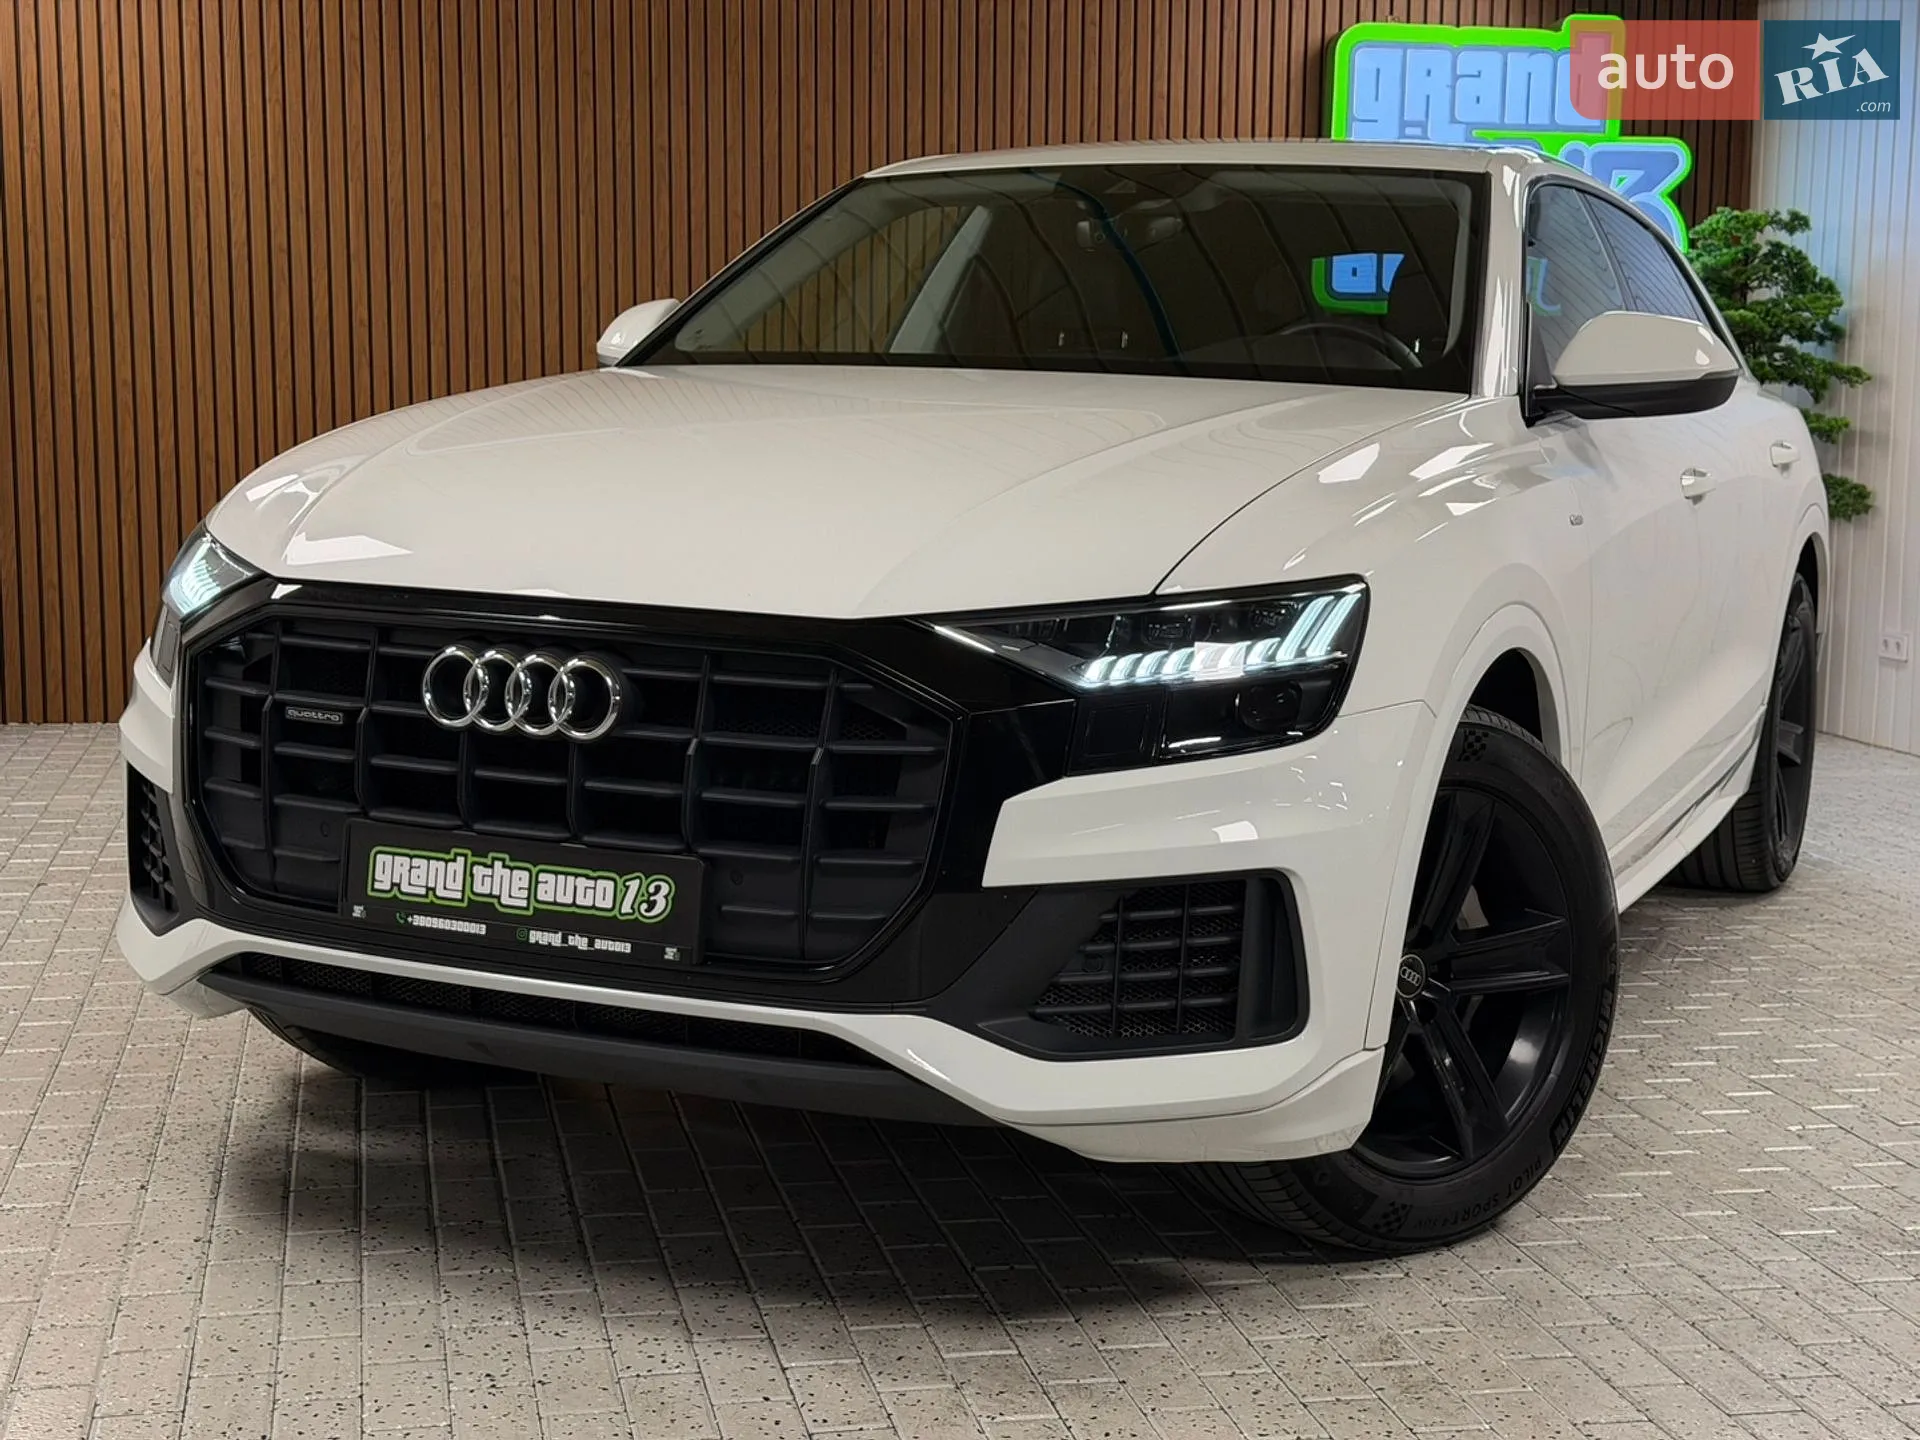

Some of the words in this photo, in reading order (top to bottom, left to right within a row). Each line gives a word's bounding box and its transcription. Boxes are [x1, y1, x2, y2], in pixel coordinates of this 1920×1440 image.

[287, 709, 339, 721] quattro
[373, 853, 465, 899] grand
[472, 861, 529, 908] the
[536, 872, 614, 910] auto
[620, 876, 671, 918] 13
[1506, 1156, 1543, 1199] PILOT
[1451, 1193, 1499, 1226] SPORT
